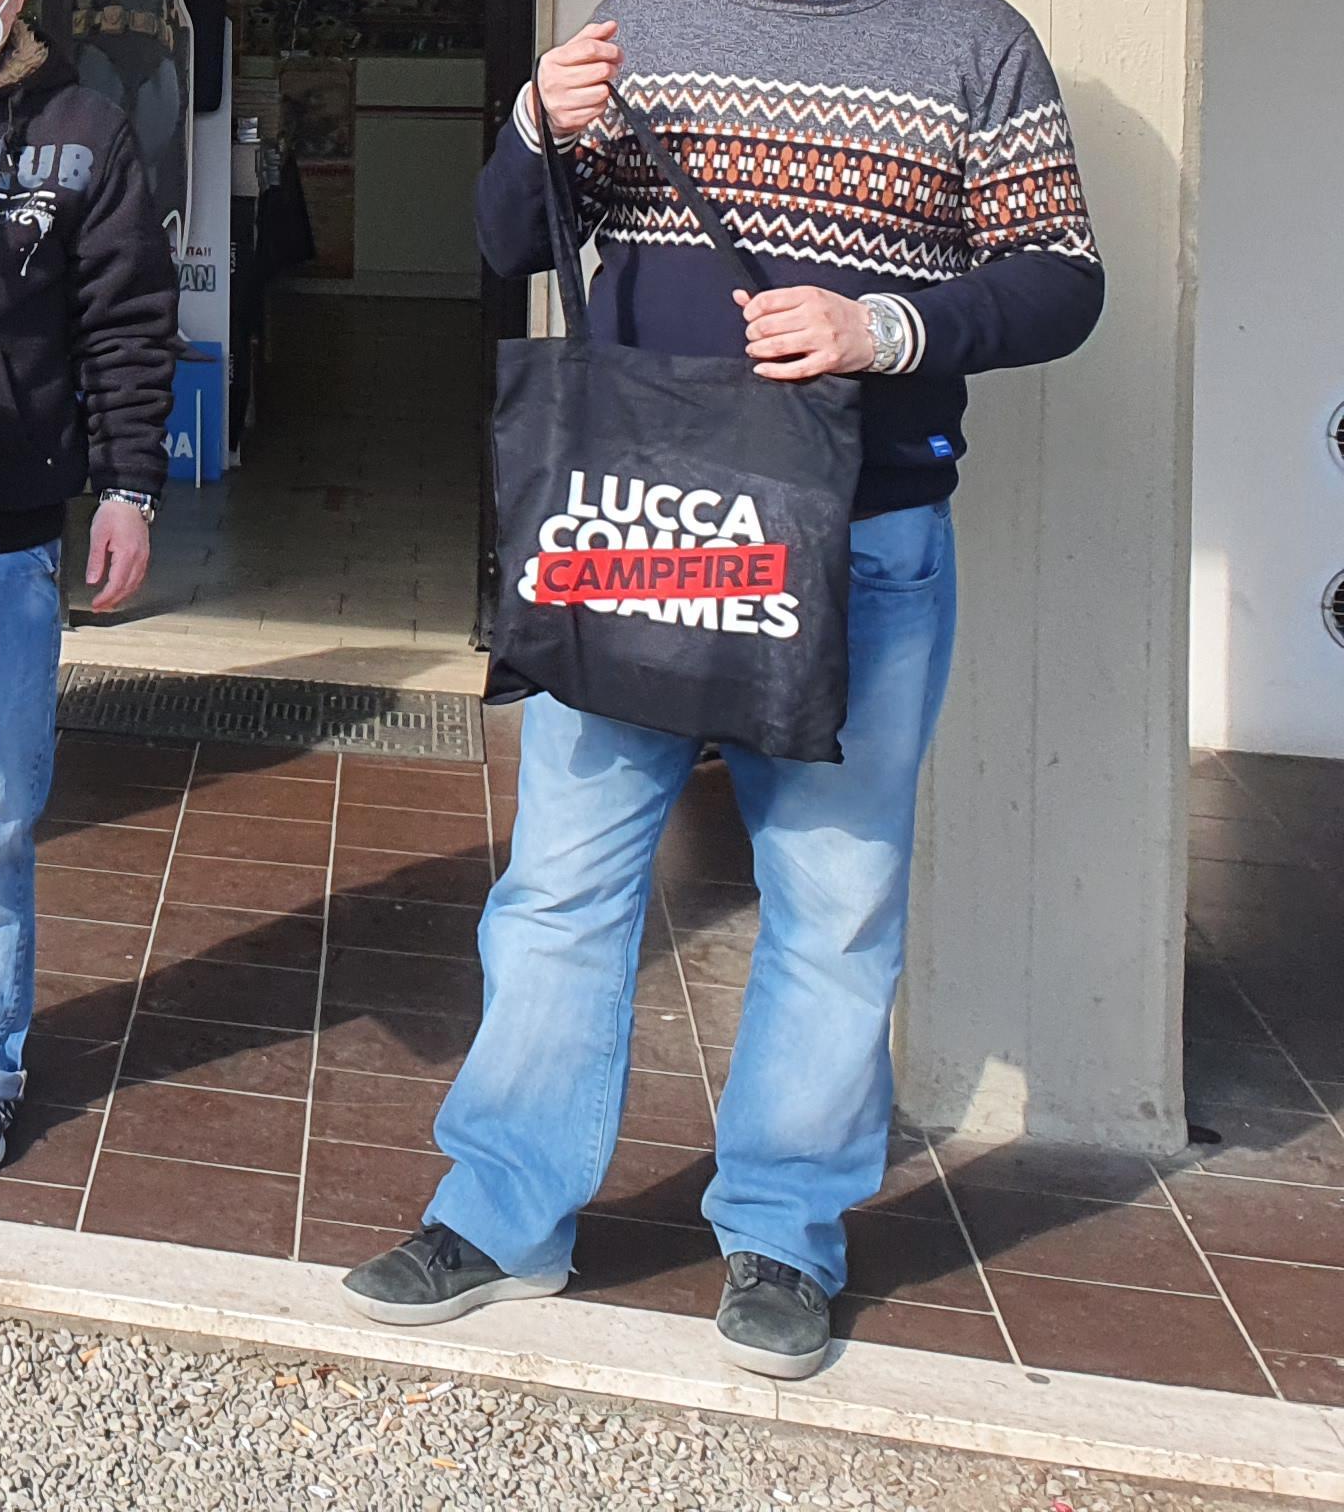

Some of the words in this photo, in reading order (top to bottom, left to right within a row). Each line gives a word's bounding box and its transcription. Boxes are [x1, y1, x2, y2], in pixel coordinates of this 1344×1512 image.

[177, 263, 216, 292] AN
[160, 431, 194, 458] RA
[566, 470, 766, 544] LUCCA
[543, 553, 775, 593] CAMPFIRE
[583, 593, 800, 639] AMES
